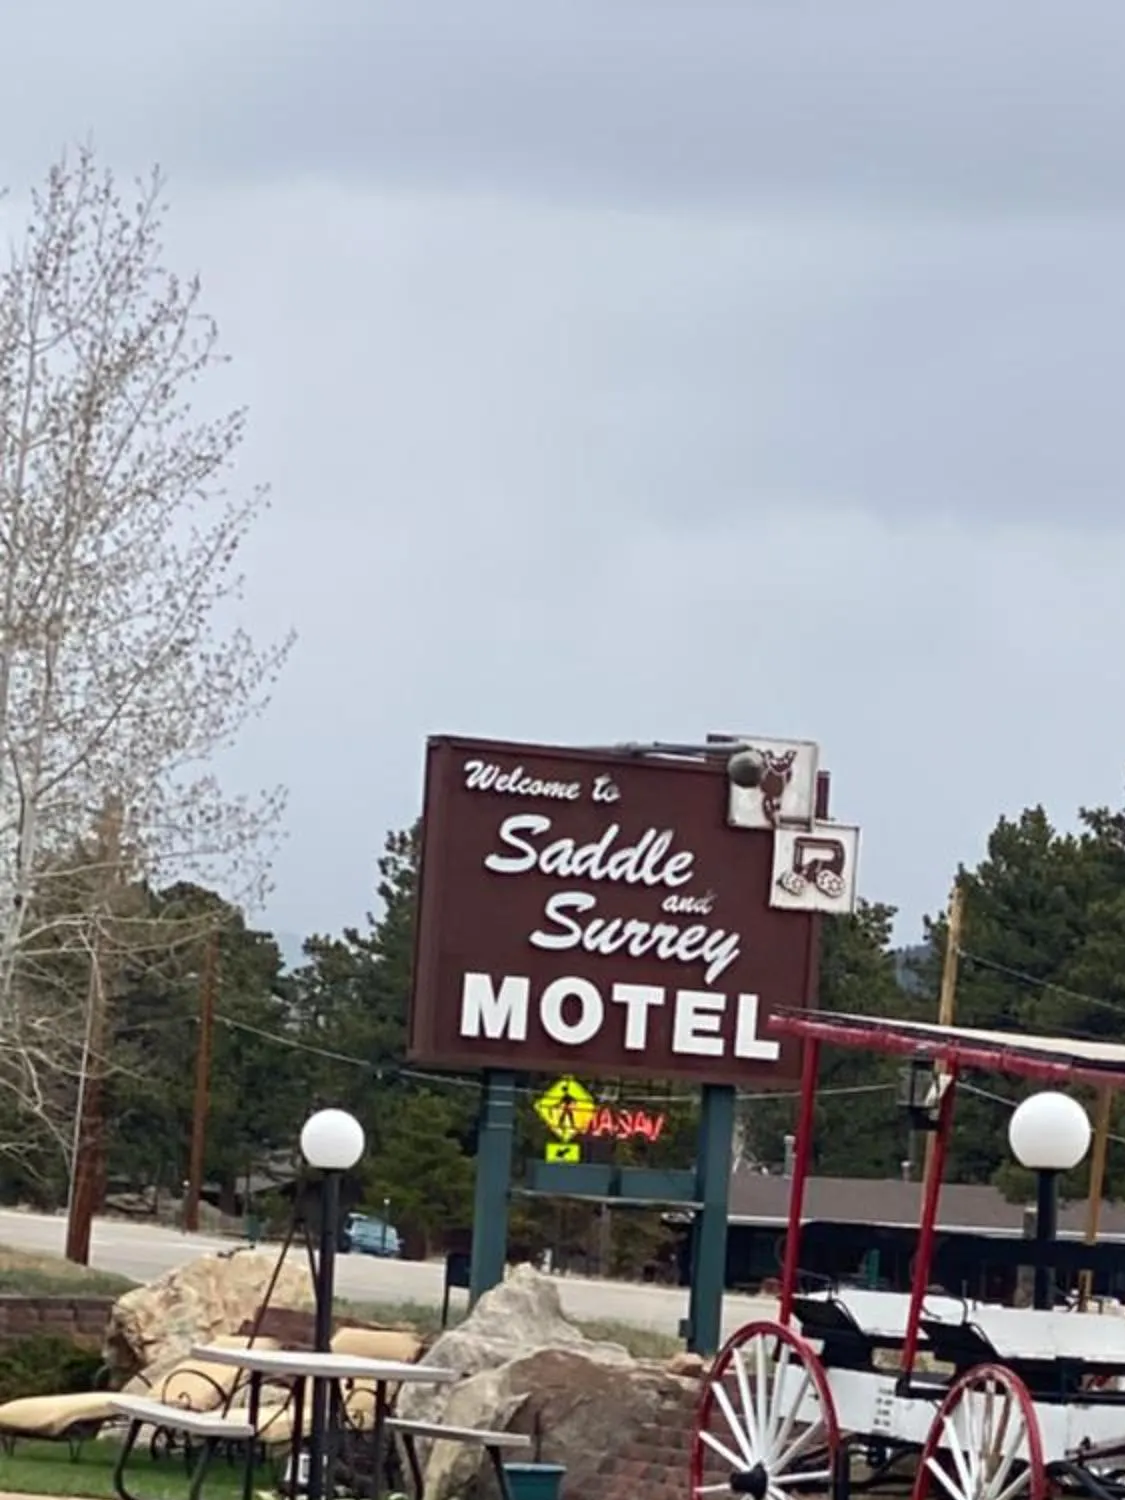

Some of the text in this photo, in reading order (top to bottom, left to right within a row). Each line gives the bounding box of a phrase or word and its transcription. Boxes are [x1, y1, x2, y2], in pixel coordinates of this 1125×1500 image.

[463, 760, 621, 802] Welcome to
[484, 814, 695, 887] Saddle
[529, 891, 741, 985] Surrey
[660, 889, 717, 915] and
[460, 972, 781, 1061] MOTEL
